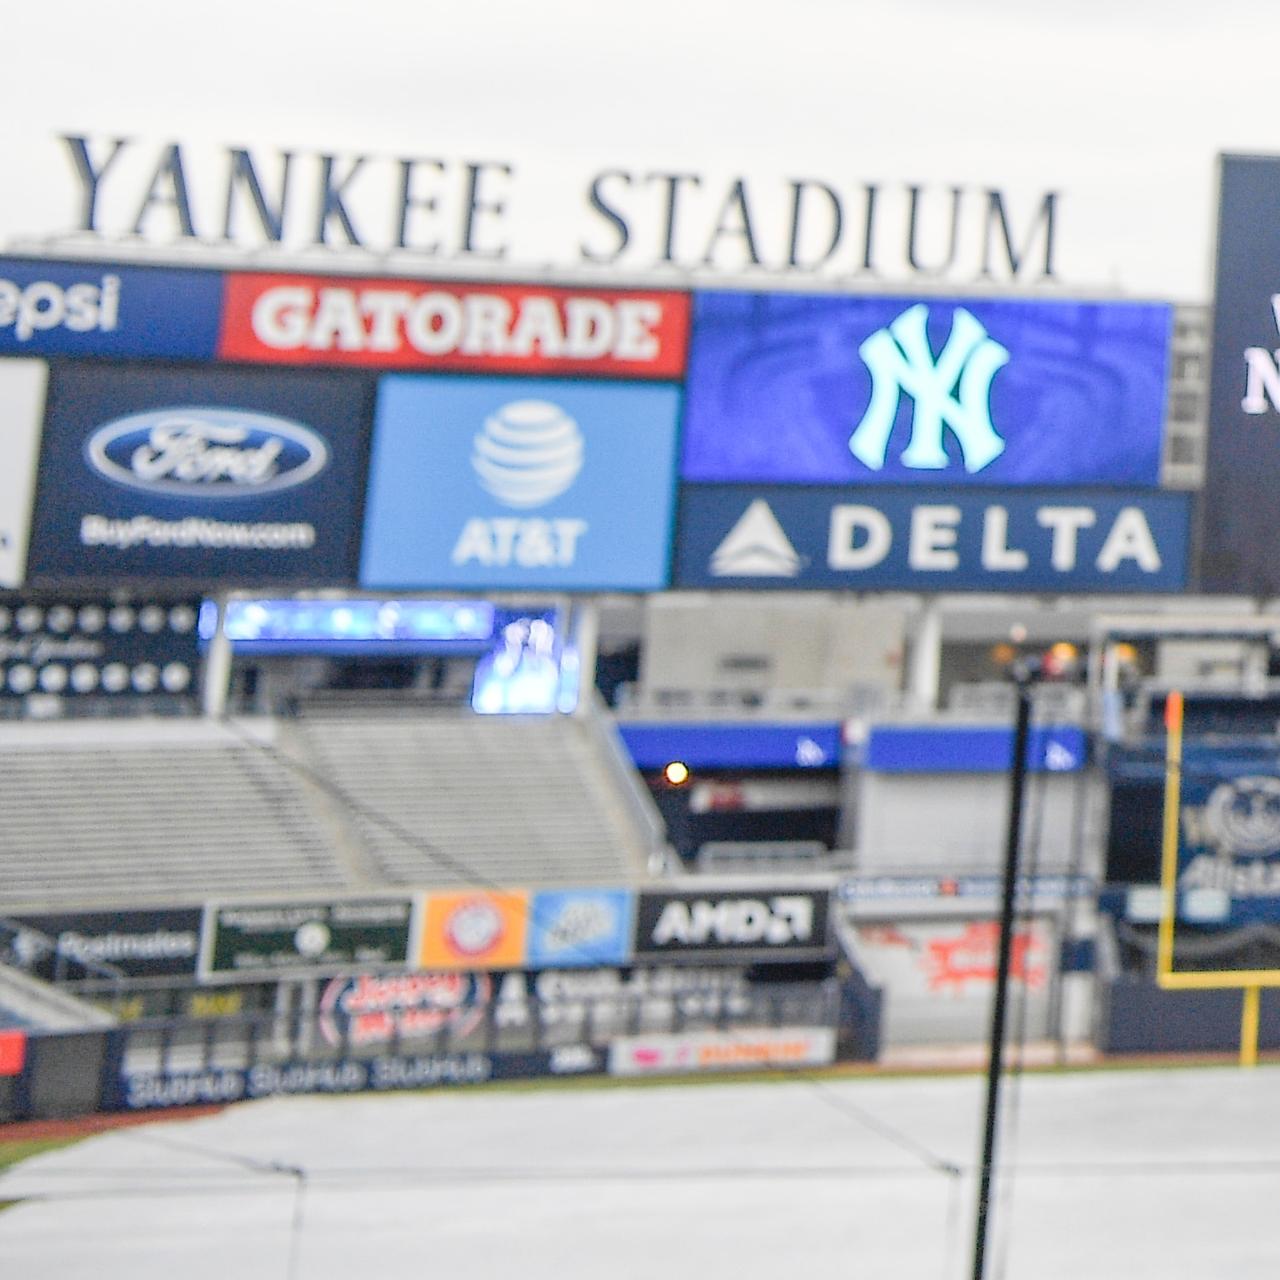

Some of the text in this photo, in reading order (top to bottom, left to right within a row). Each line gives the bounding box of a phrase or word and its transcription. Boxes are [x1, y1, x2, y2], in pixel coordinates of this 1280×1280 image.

[59, 134, 1067, 281] YANKEE STADIUM
[251, 285, 662, 361] GATORADE
[849, 302, 1010, 475] NY
[131, 417, 284, 485] Ford
[451, 518, 587, 569] AT&T
[827, 504, 1163, 574] DELTA
[651, 899, 771, 945] AMD
